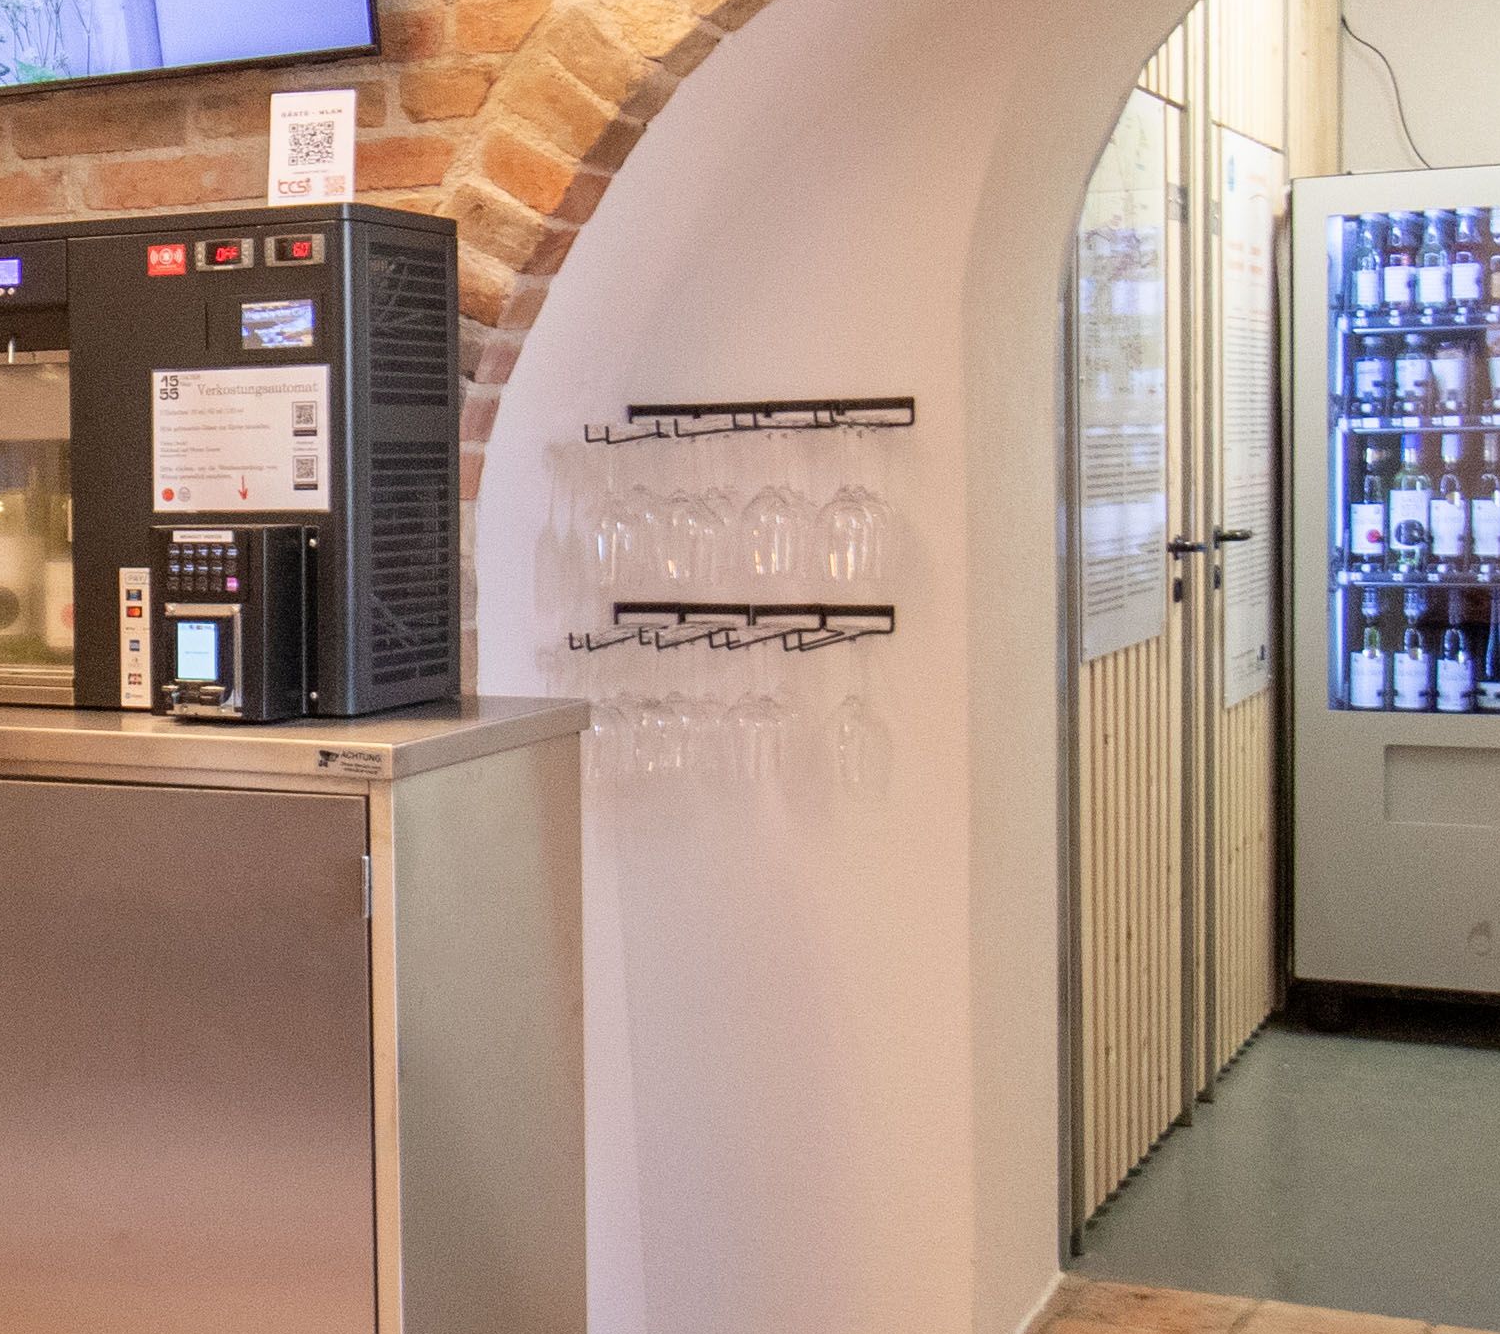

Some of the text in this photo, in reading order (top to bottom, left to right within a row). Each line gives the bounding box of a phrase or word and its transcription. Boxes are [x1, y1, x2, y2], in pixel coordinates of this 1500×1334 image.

[215, 246, 239, 262] OFF
[160, 374, 179, 387] 15
[159, 387, 179, 400] 55
[197, 381, 319, 397] Verkostungsautomat
